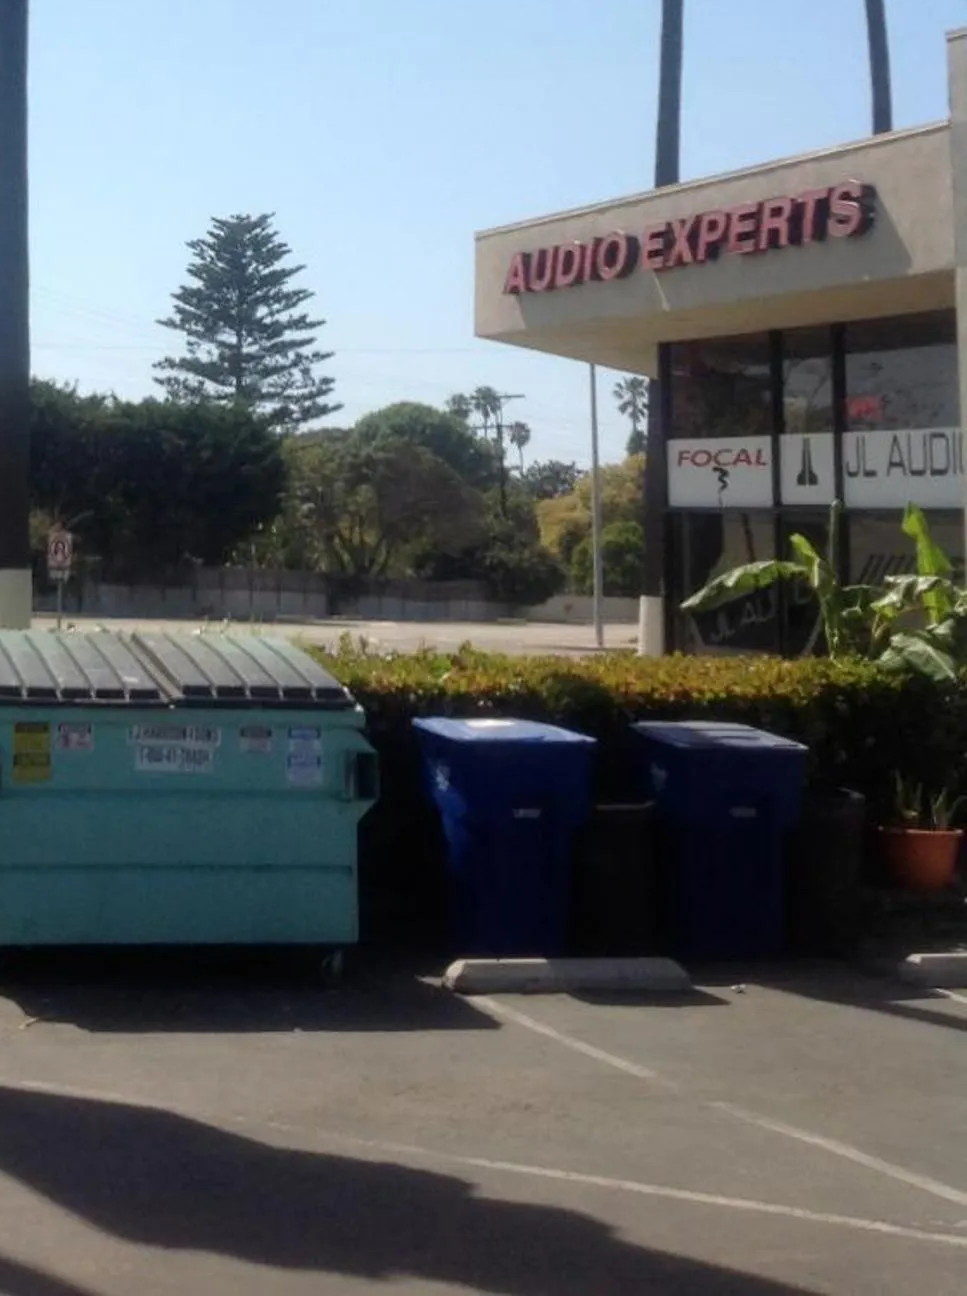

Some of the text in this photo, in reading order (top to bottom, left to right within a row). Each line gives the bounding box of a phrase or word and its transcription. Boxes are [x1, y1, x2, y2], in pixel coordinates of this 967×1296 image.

[503, 179, 864, 294] AUDIO EXPERTS
[676, 447, 768, 469] FOCAL
[845, 432, 965, 478] JL AUDI
